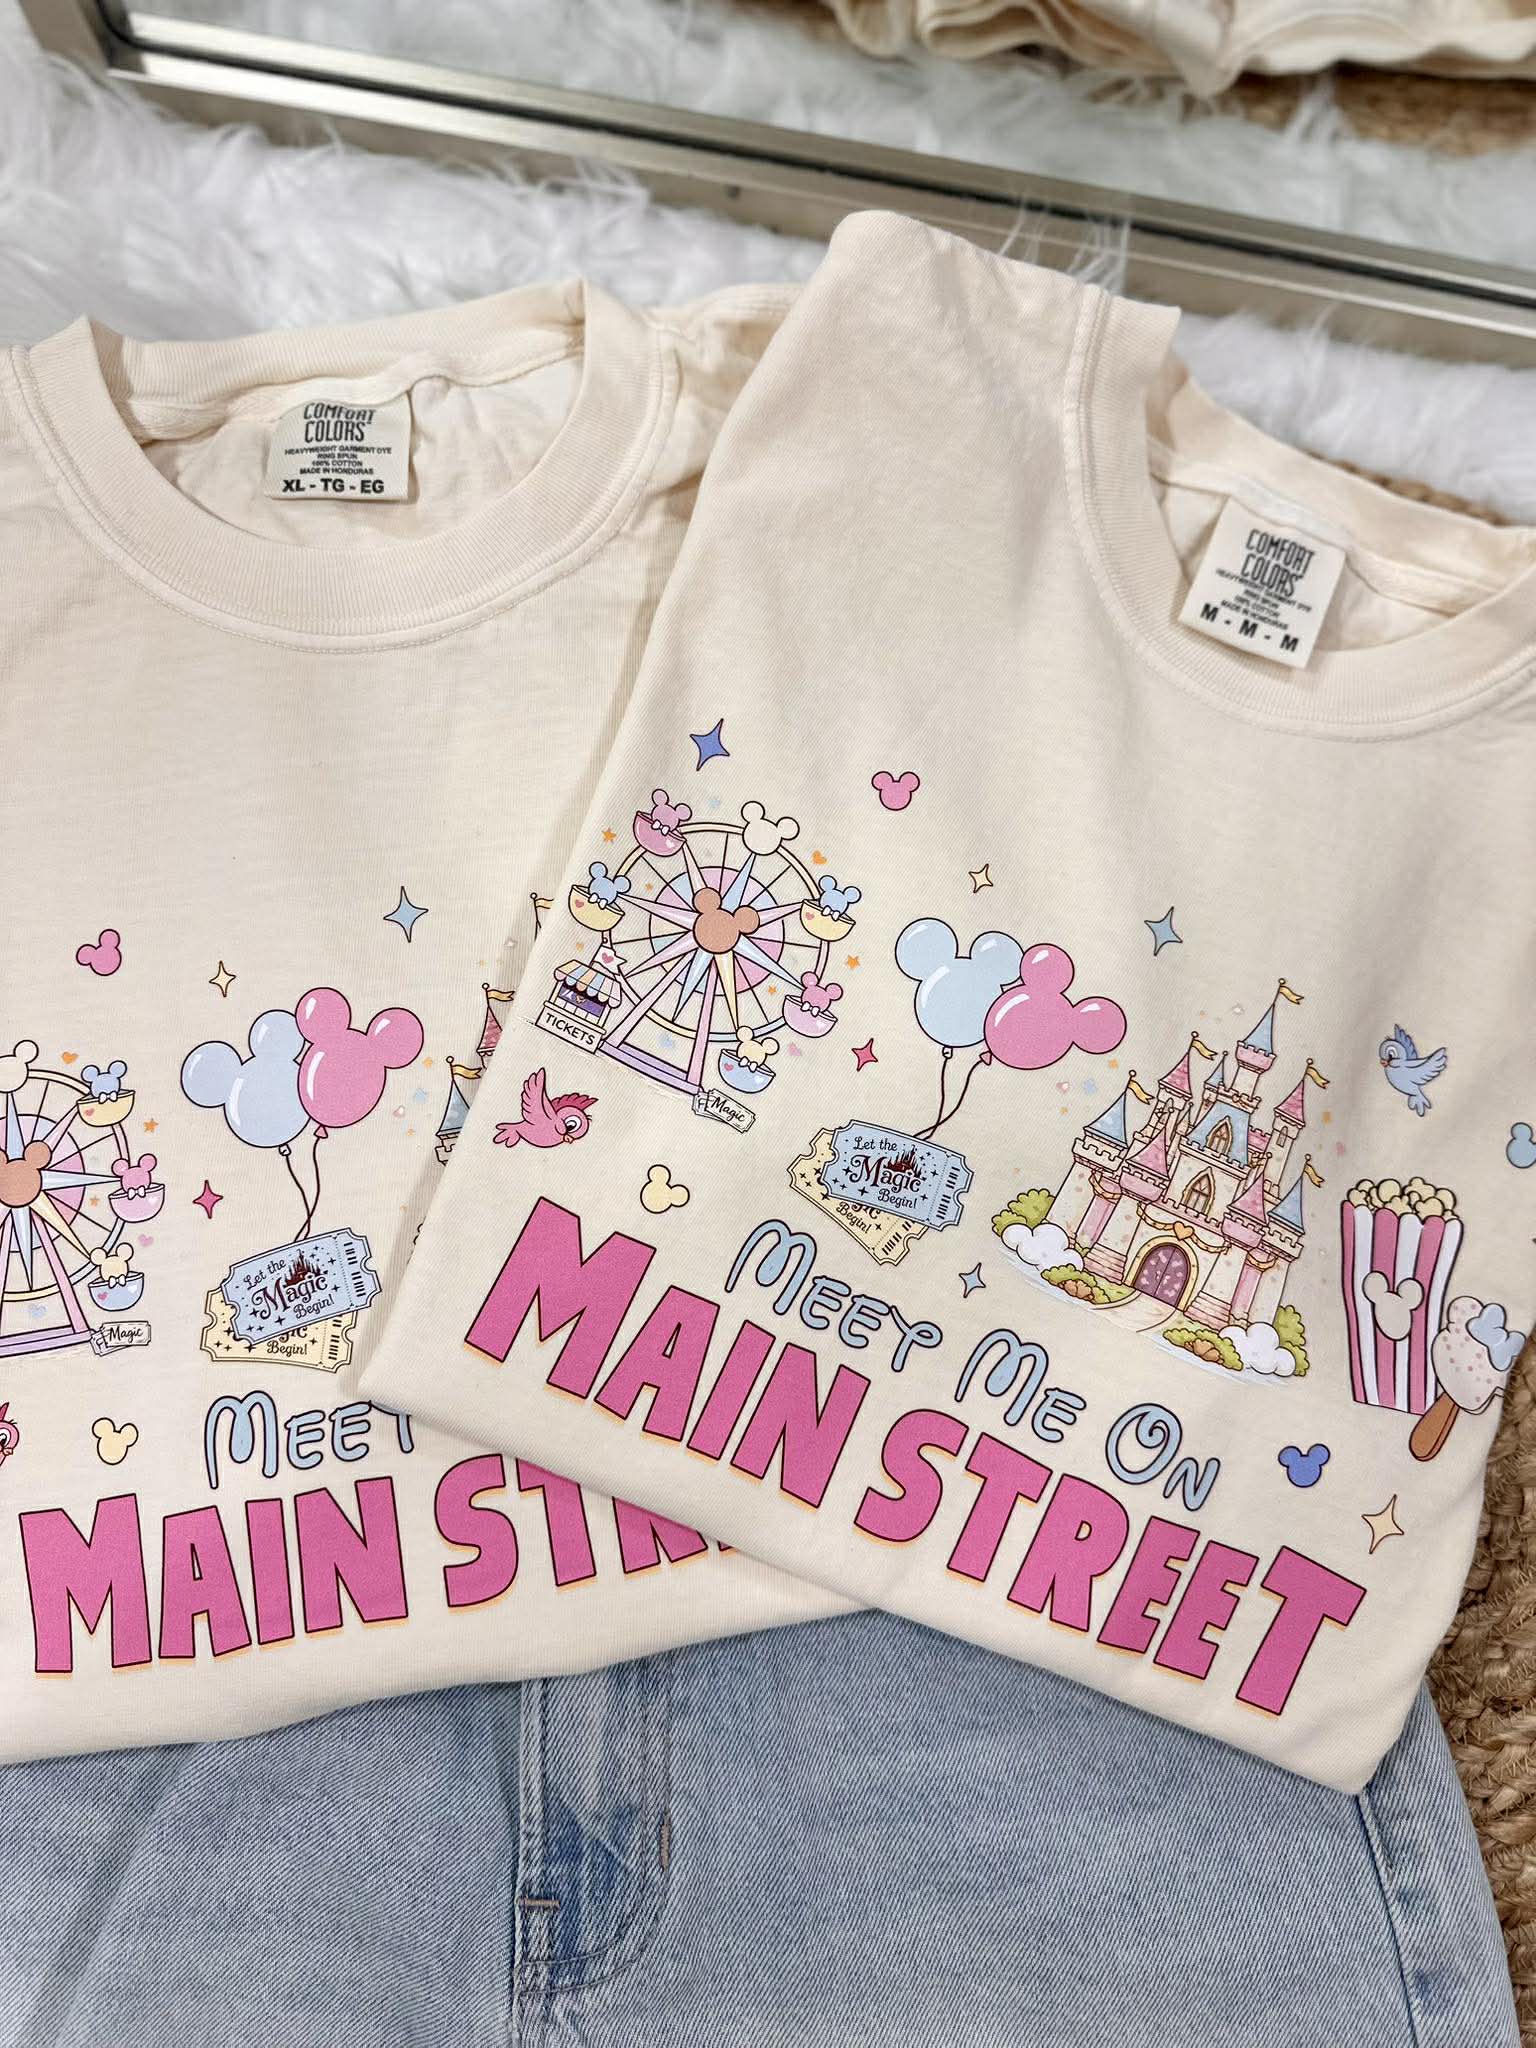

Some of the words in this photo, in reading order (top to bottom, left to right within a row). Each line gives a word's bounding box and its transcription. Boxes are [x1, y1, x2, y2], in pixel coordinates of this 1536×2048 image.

[304, 402, 376, 422] COMFORT
[304, 420, 367, 443] COLORS
[282, 479, 305, 493] XL
[320, 478, 345, 493] TG
[360, 480, 385, 494] EG
[1246, 529, 1316, 576] COMFORT
[1240, 553, 1299, 597] COLORS
[1200, 603, 1219, 622] M
[1238, 619, 1258, 638] M
[1280, 634, 1299, 652] M
[544, 1012, 597, 1045] TICKETS
[710, 1096, 745, 1122] Magic
[852, 1136, 875, 1151] Let
[879, 1137, 897, 1151] the
[850, 1155, 922, 1193] Magic
[877, 1188, 918, 1209] Begin!
[835, 1201, 872, 1234] Begin!
[243, 1269, 267, 1291] Let
[267, 1259, 287, 1275] the
[252, 1274, 328, 1320] Magic
[293, 1293, 335, 1319] Begin!
[109, 1325, 143, 1343] Magic
[266, 1340, 308, 1357] Begin!
[724, 1218, 943, 1372] MEET
[954, 1328, 1087, 1443] ME
[1105, 1402, 1221, 1512] ON
[462, 1196, 873, 1513] MAIN
[853, 1408, 1368, 1718] STREET
[18, 1475, 411, 1676] MAIN
